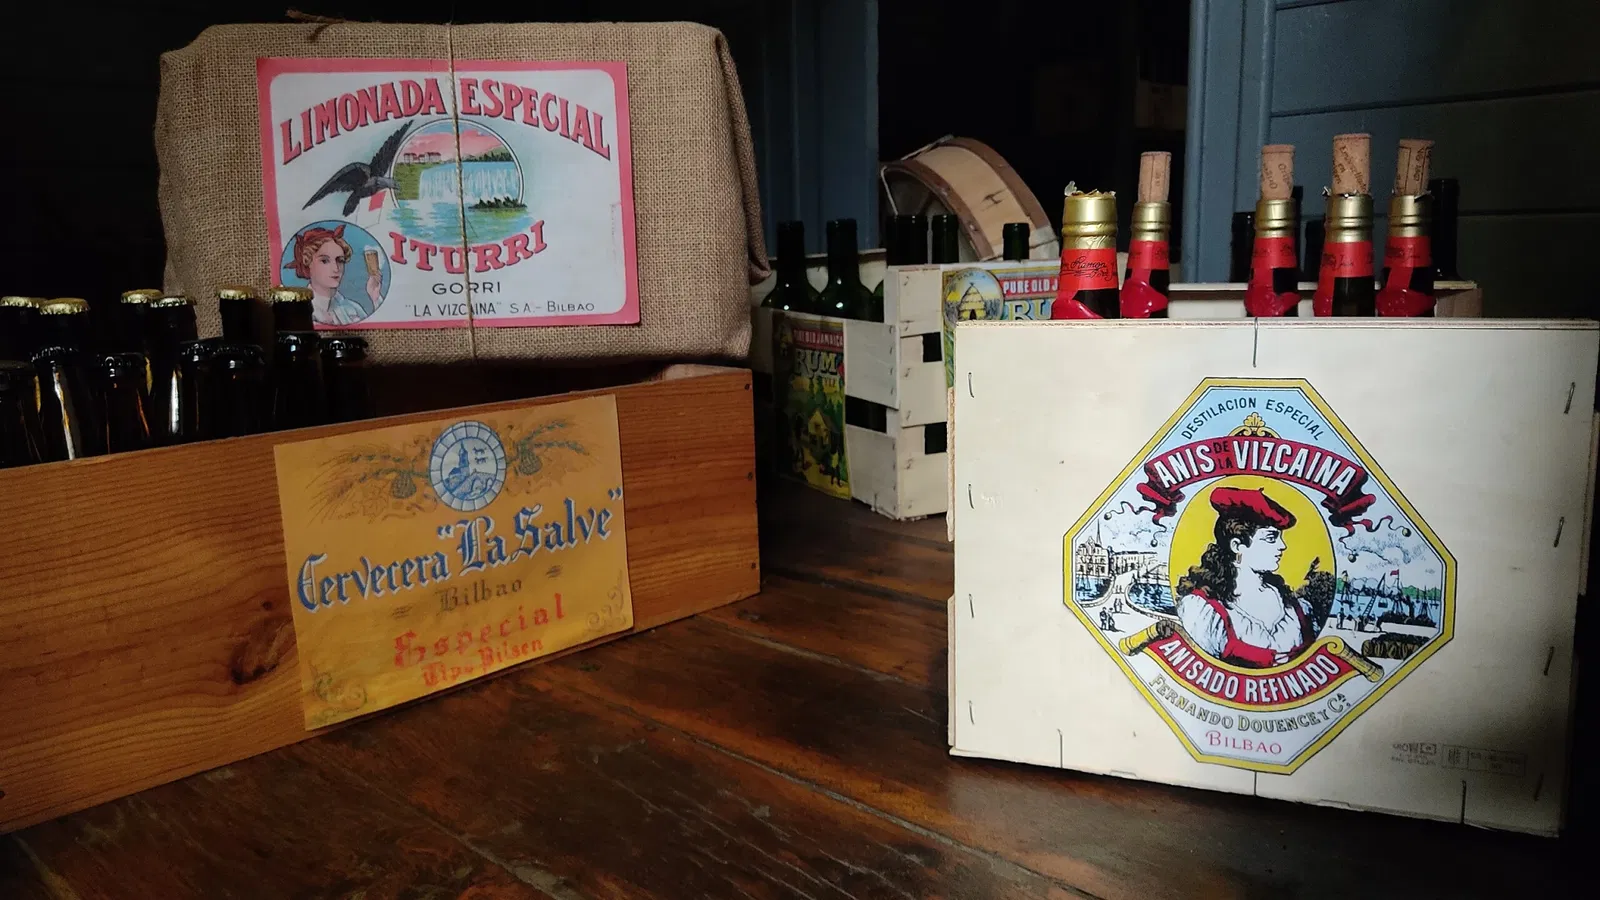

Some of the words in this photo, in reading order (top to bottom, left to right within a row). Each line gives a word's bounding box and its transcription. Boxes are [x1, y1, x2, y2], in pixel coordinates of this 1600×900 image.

[280, 78, 447, 165] LIMONADA
[458, 78, 611, 161] ESPECIAL
[389, 220, 547, 274] ITURRI
[432, 281, 501, 295] GORRI
[1003, 280, 1029, 294] PURE
[1031, 279, 1050, 292] OLD
[1004, 298, 1058, 320] RU
[794, 348, 838, 380] RUM
[1181, 397, 1257, 440] DESTILACION
[1265, 399, 1325, 441] ESPECIAL
[1153, 444, 1215, 489] ANIS
[1213, 440, 1229, 454] DE
[1218, 456, 1233, 470] LA
[1232, 440, 1357, 496] VIZCAINA
[297, 550, 452, 613] Cervecera
[435, 579, 522, 612] Bilbao
[394, 592, 564, 666] Especial
[1158, 639, 1239, 699] ANISADO
[1244, 653, 1341, 703] REFINADO
[1150, 673, 1234, 730] FERNANDO
[1237, 711, 1321, 733] DOUENCE
